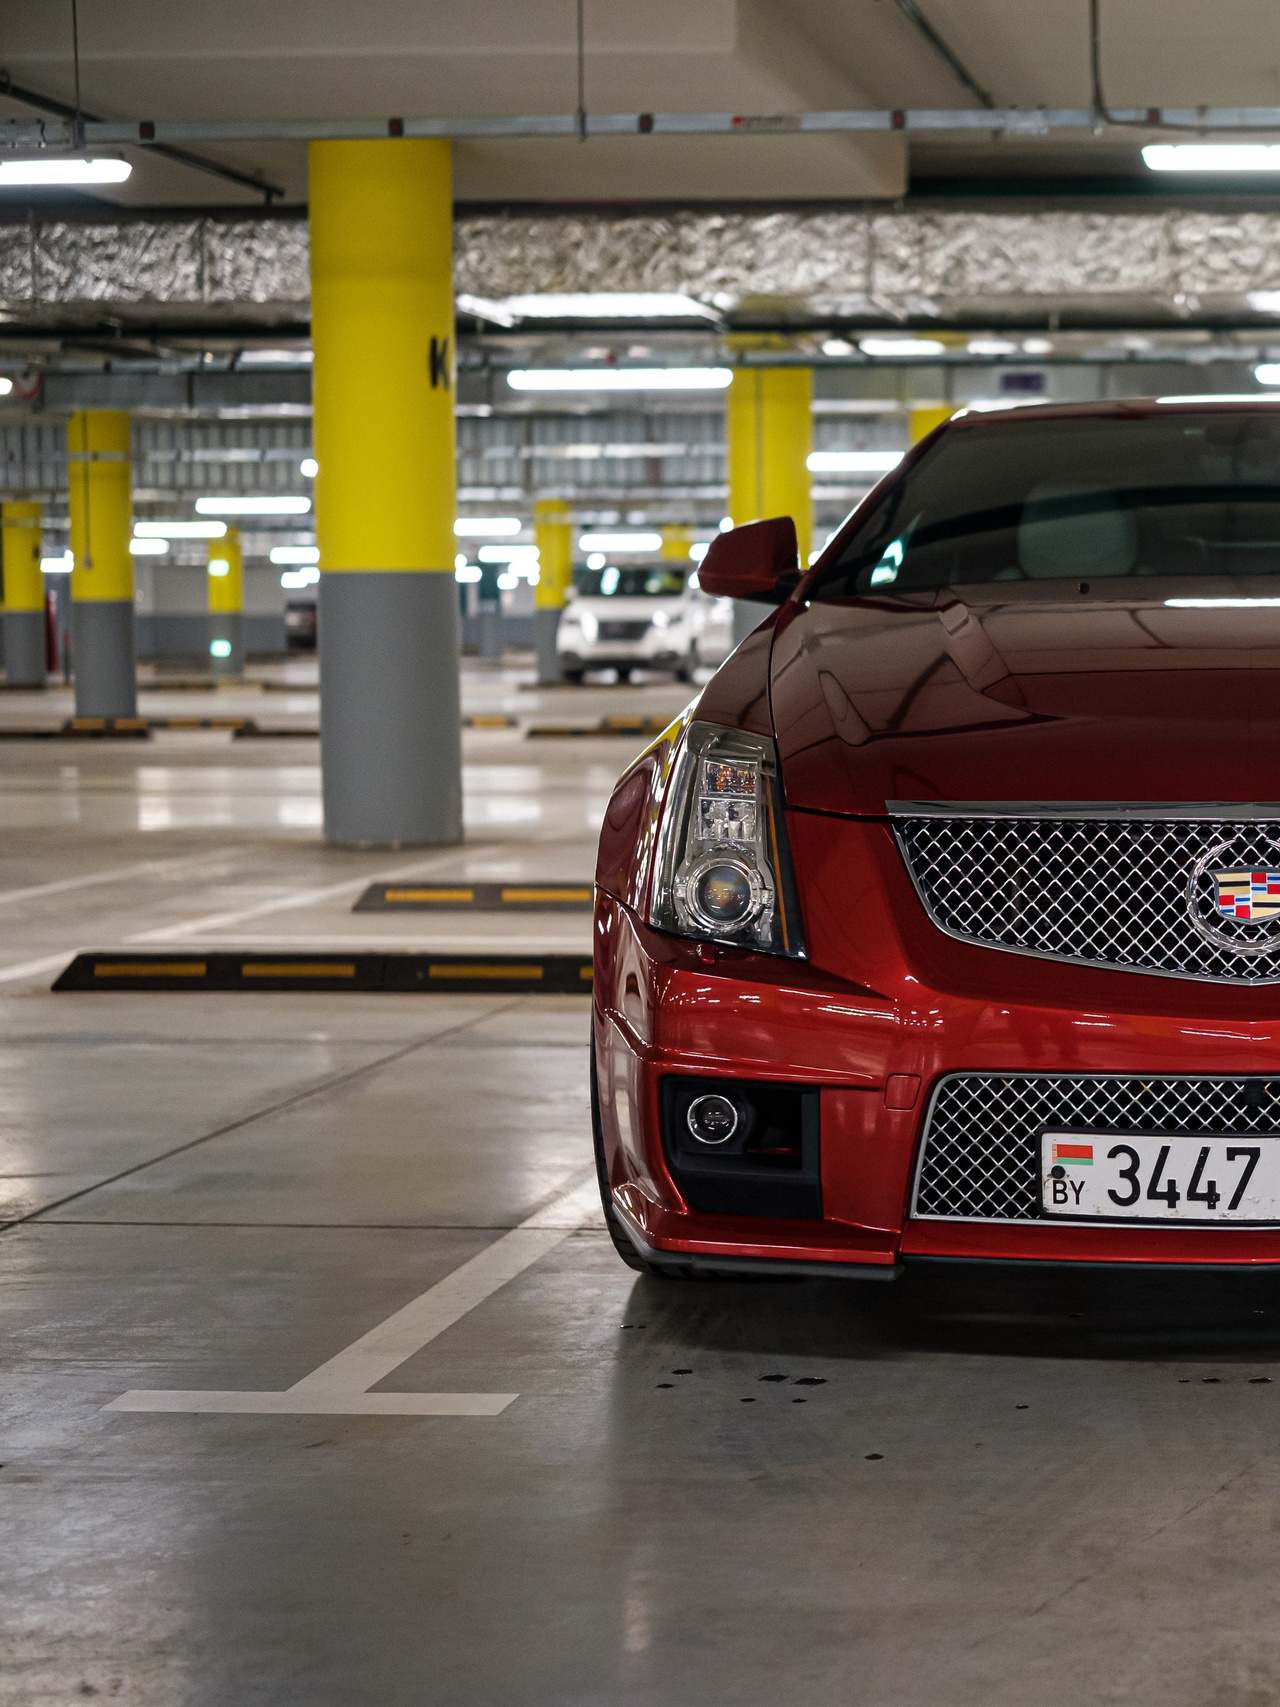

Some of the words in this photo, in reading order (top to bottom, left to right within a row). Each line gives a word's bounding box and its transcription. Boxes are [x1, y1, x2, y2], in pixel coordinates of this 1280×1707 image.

[430, 337, 449, 391] K
[1052, 1179, 1086, 1205] BY
[1106, 1143, 1262, 1210] 3447
